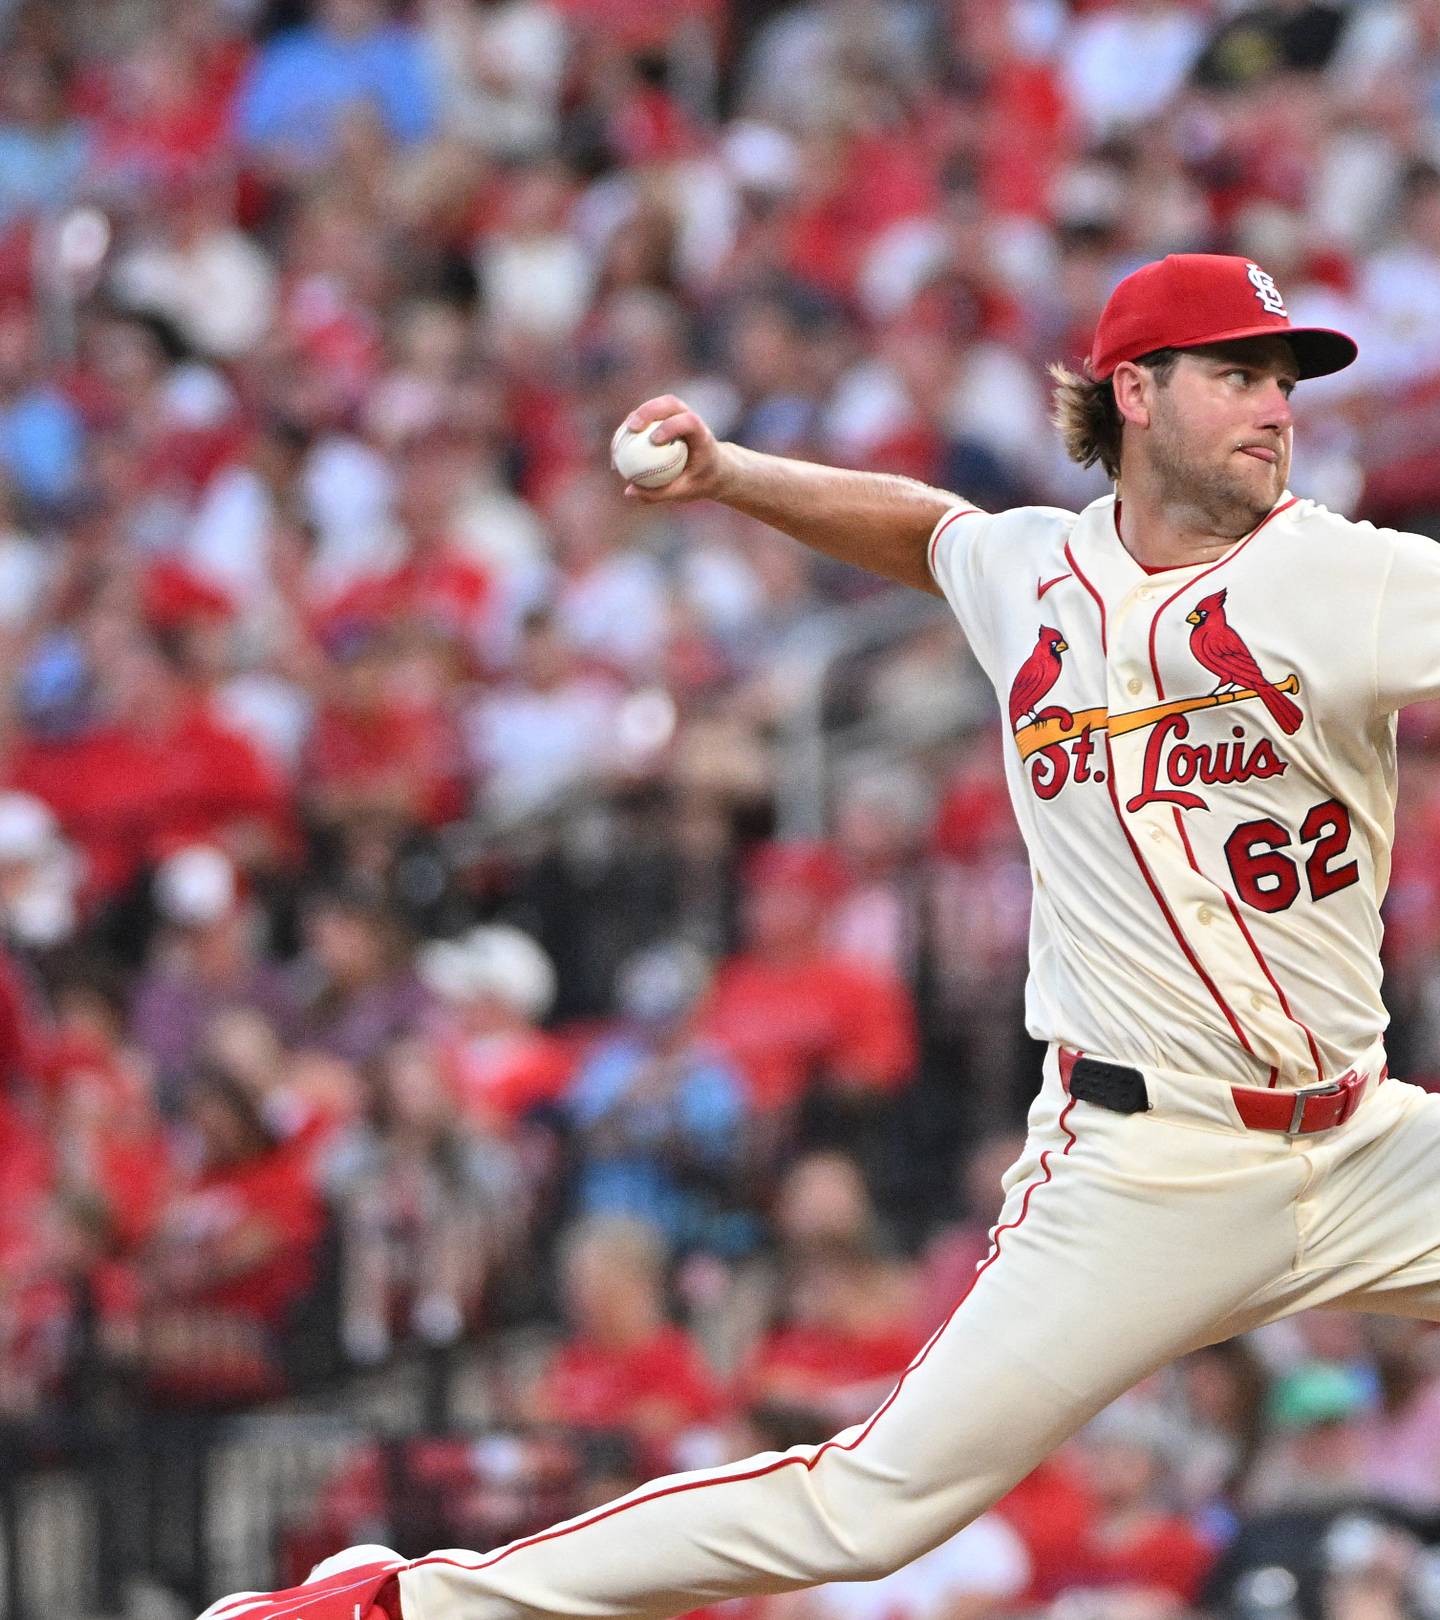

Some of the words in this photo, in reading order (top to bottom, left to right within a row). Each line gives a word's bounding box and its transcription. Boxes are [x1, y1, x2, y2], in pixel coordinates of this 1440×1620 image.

[1031, 705, 1107, 800] St.
[1126, 713, 1289, 813] Louis
[1223, 798, 1360, 914] 62
